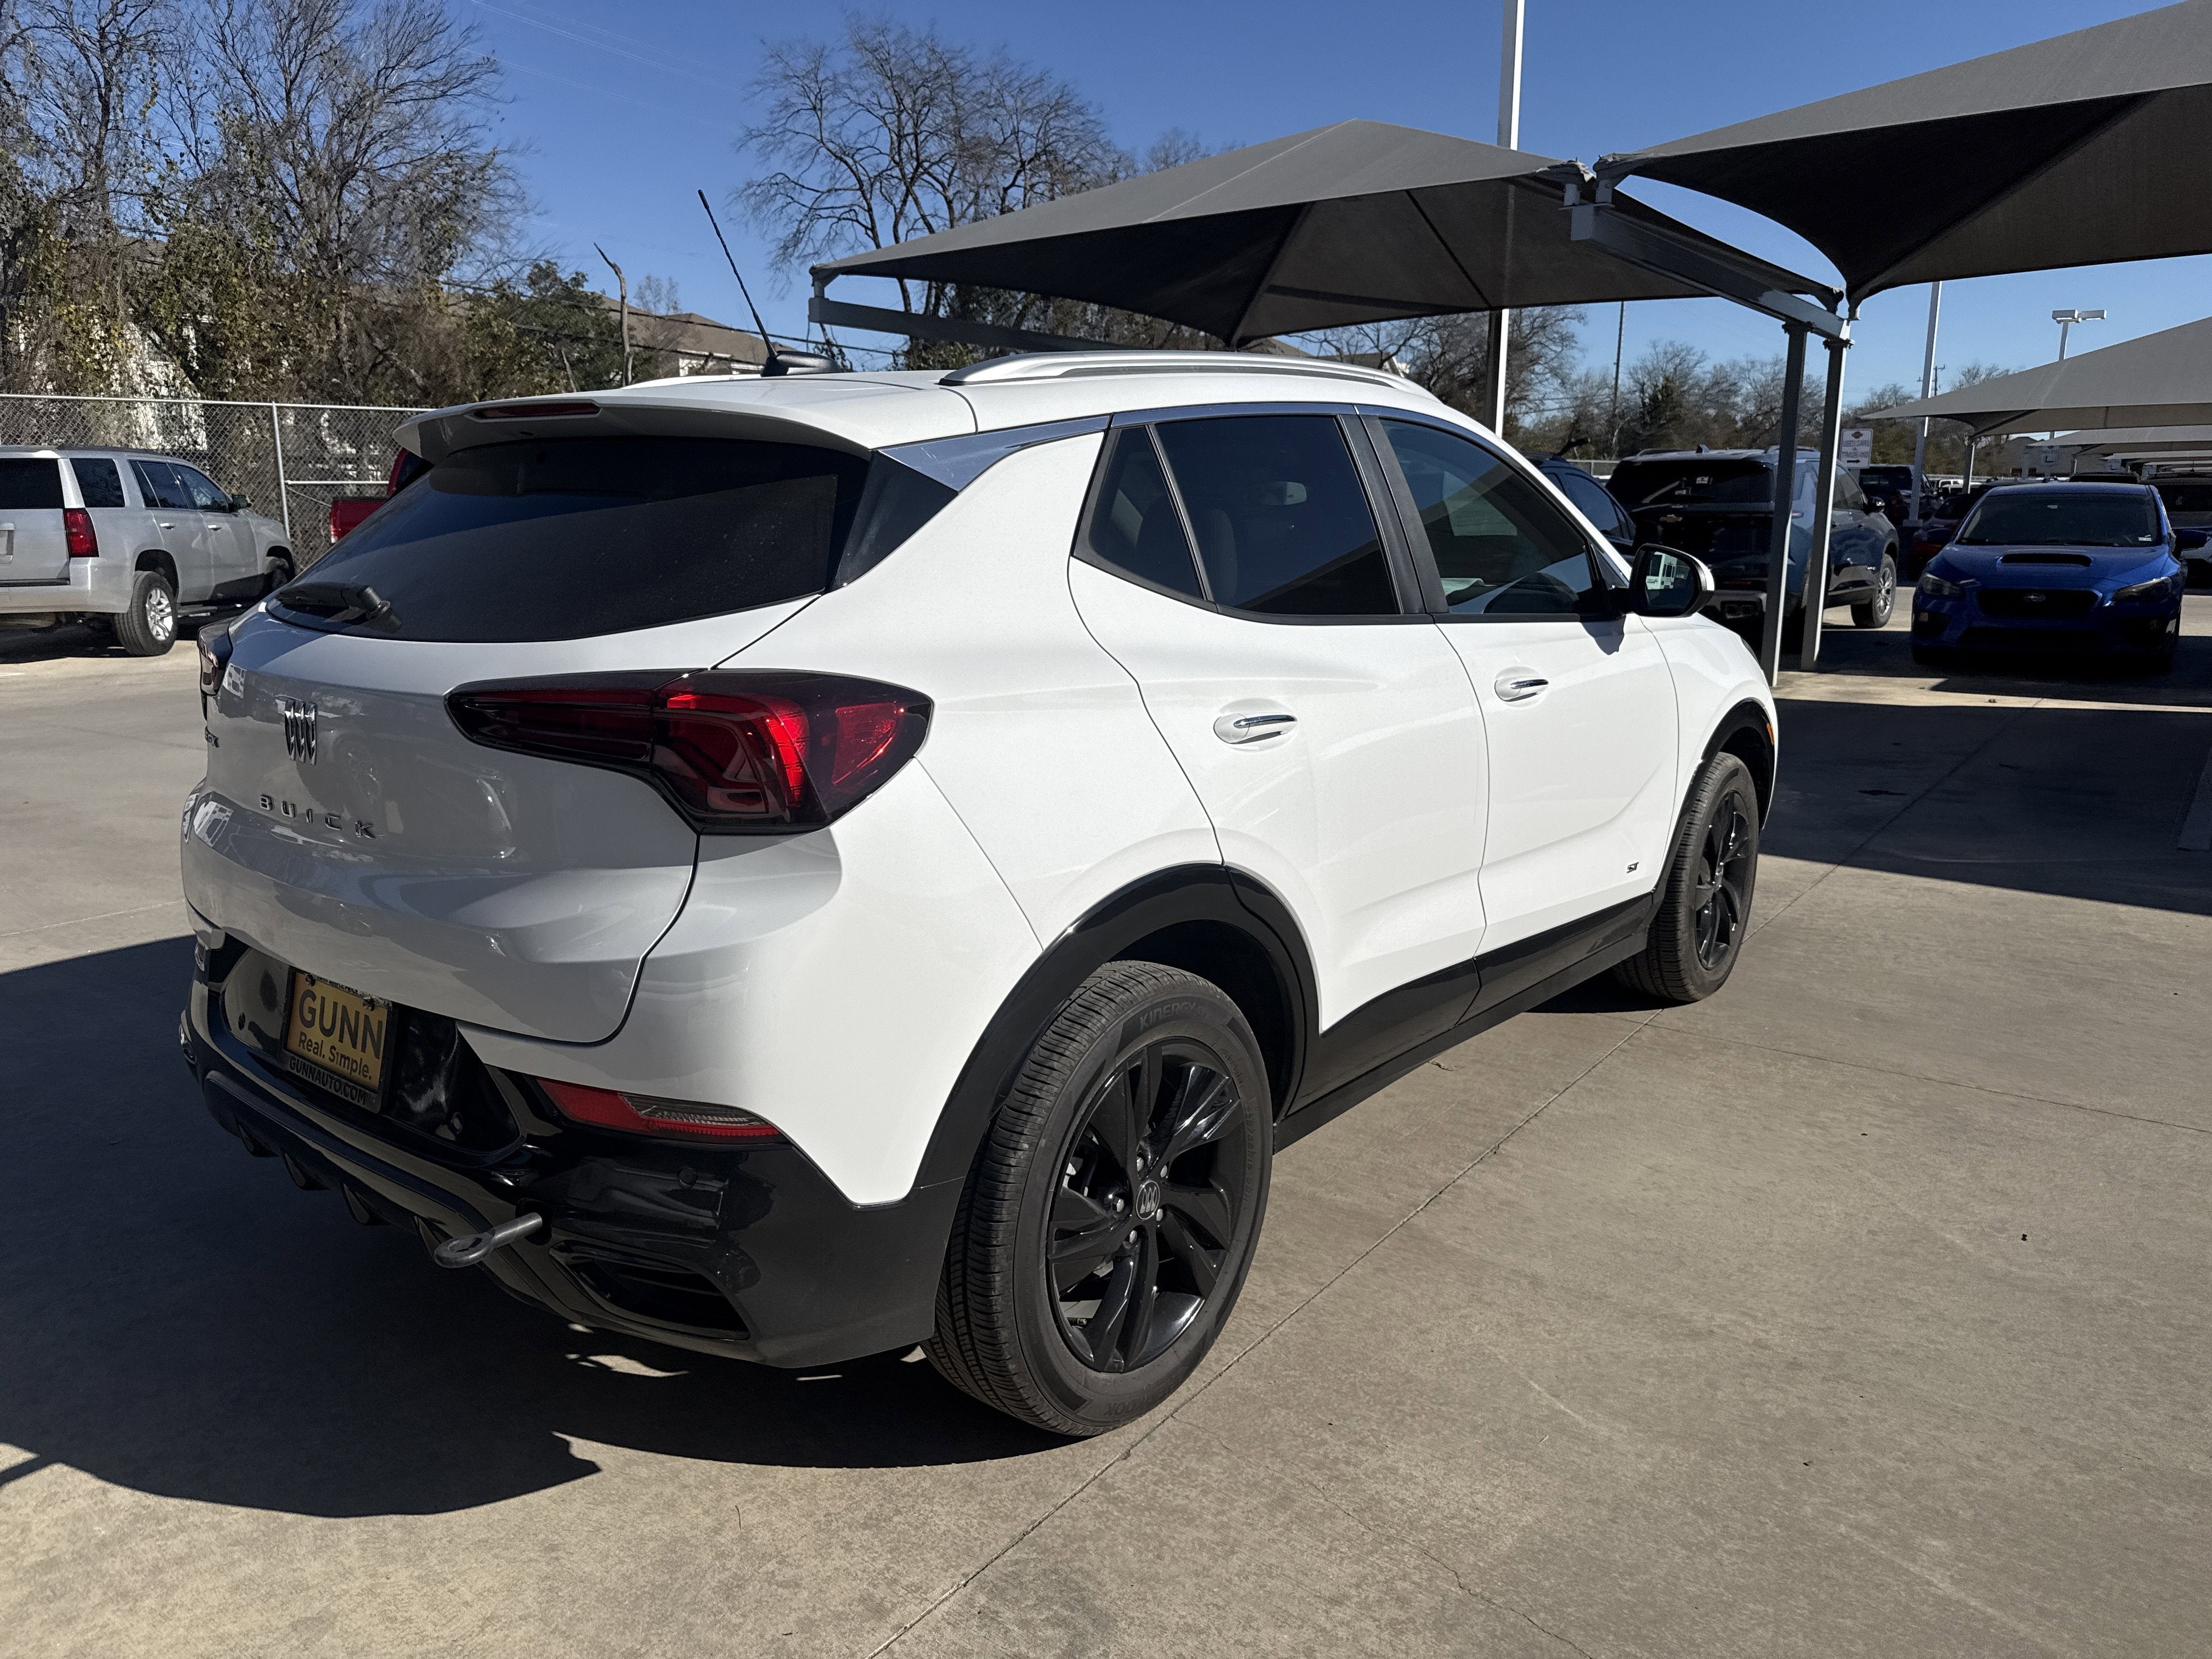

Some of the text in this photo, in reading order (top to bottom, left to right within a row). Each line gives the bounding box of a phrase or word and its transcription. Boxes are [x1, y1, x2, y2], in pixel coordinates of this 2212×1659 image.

[261, 794, 375, 839] BUICK
[298, 1031, 325, 1058] Real.
[299, 989, 383, 1060] GUNN
[289, 1058, 368, 1105] GUNNAUTO.COM
